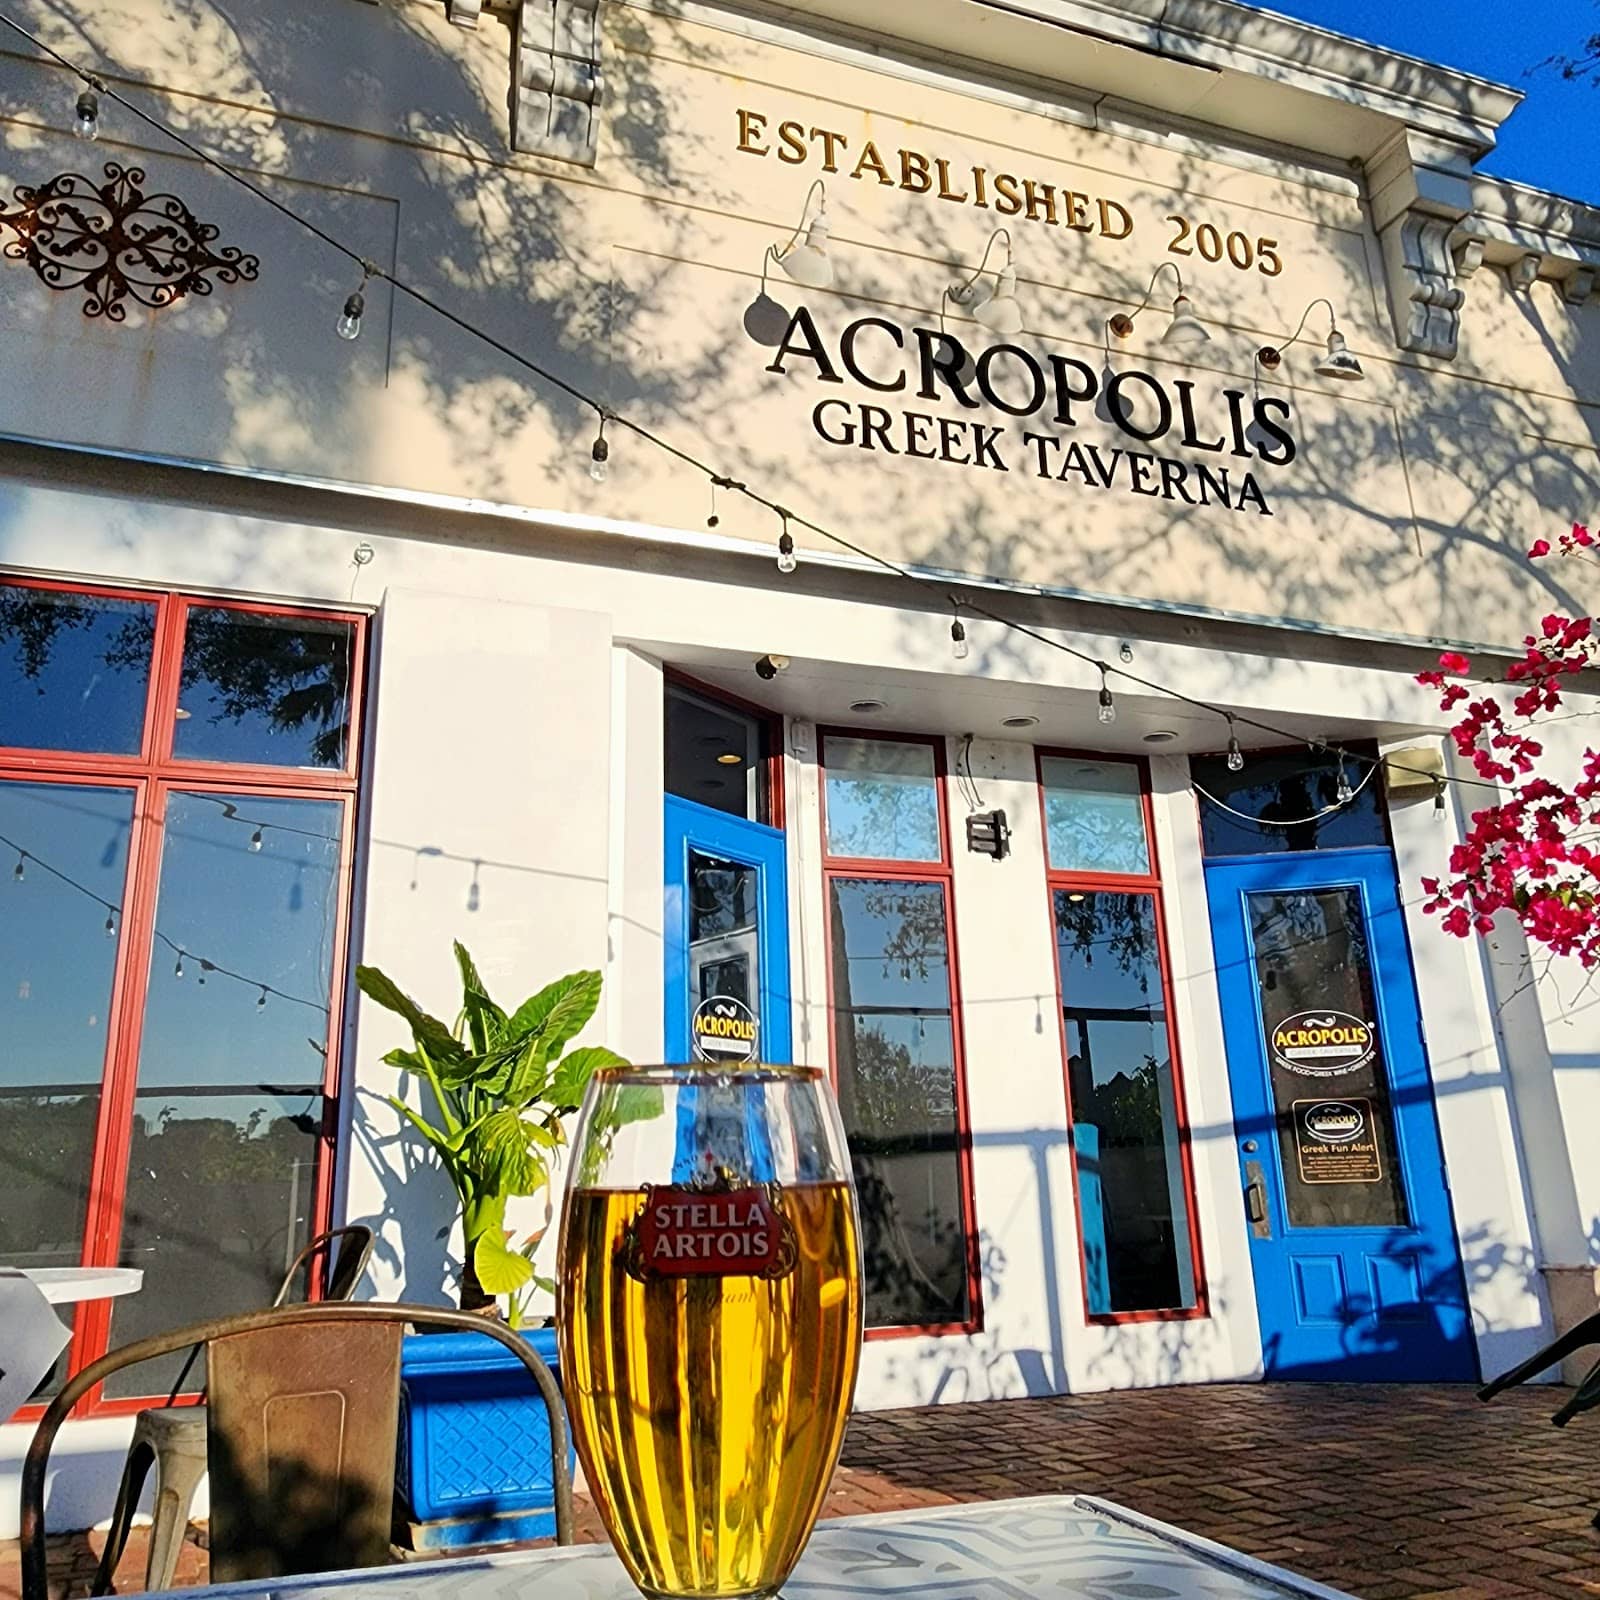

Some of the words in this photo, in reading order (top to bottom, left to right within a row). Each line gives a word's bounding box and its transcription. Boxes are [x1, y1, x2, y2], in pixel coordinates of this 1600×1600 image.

[736, 108, 1134, 240] ESTABLISHED
[1166, 215, 1283, 276] 2005
[766, 306, 1297, 466] ACROPOLIS
[812, 399, 1009, 472] GREEK
[1023, 432, 1273, 515] TAVERNA
[695, 1014, 756, 1040] ACROPOLIS
[1276, 1026, 1368, 1047] ACROPOLIS
[1310, 1115, 1358, 1125] ACROPOLIS
[1302, 1144, 1329, 1153] Greek
[1331, 1144, 1348, 1153] Fun
[1351, 1143, 1374, 1152] Alert
[655, 1203, 767, 1229] STELLA
[652, 1232, 769, 1259] ARTOIS
